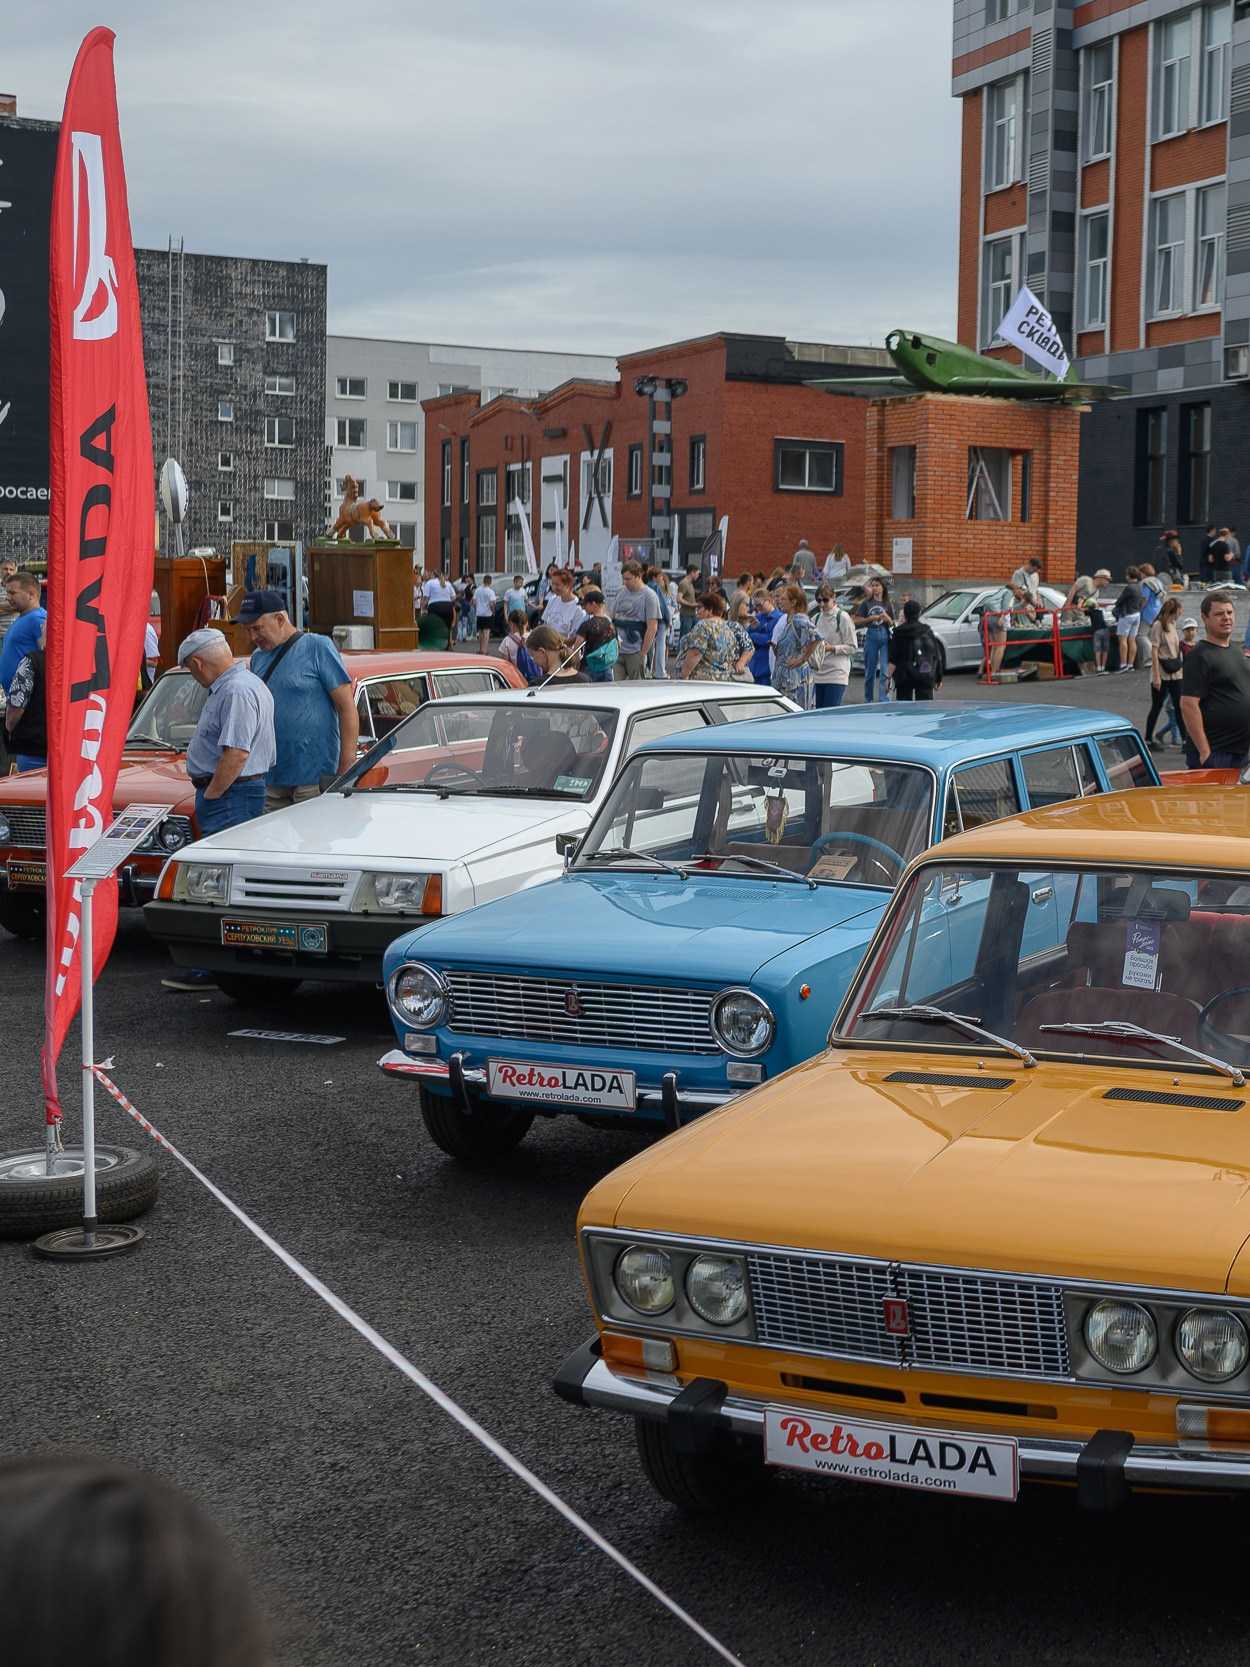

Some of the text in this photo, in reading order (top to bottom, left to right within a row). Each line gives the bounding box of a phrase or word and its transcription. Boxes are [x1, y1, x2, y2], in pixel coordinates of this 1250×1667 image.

[241, 925, 278, 934] РЕТРОКЛУБ
[227, 933, 295, 946] СЕРПУХОВСКИЙ УЕЗД
[1130, 955, 1154, 964] Большая
[1129, 962, 1153, 971] просьба,
[1128, 970, 1152, 979] руками
[498, 1065, 624, 1095] RetroLADA
[519, 1090, 602, 1104] www.retrolada.com
[780, 1417, 998, 1477] RetroLADA
[814, 1459, 957, 1489] www.retrolada.com
